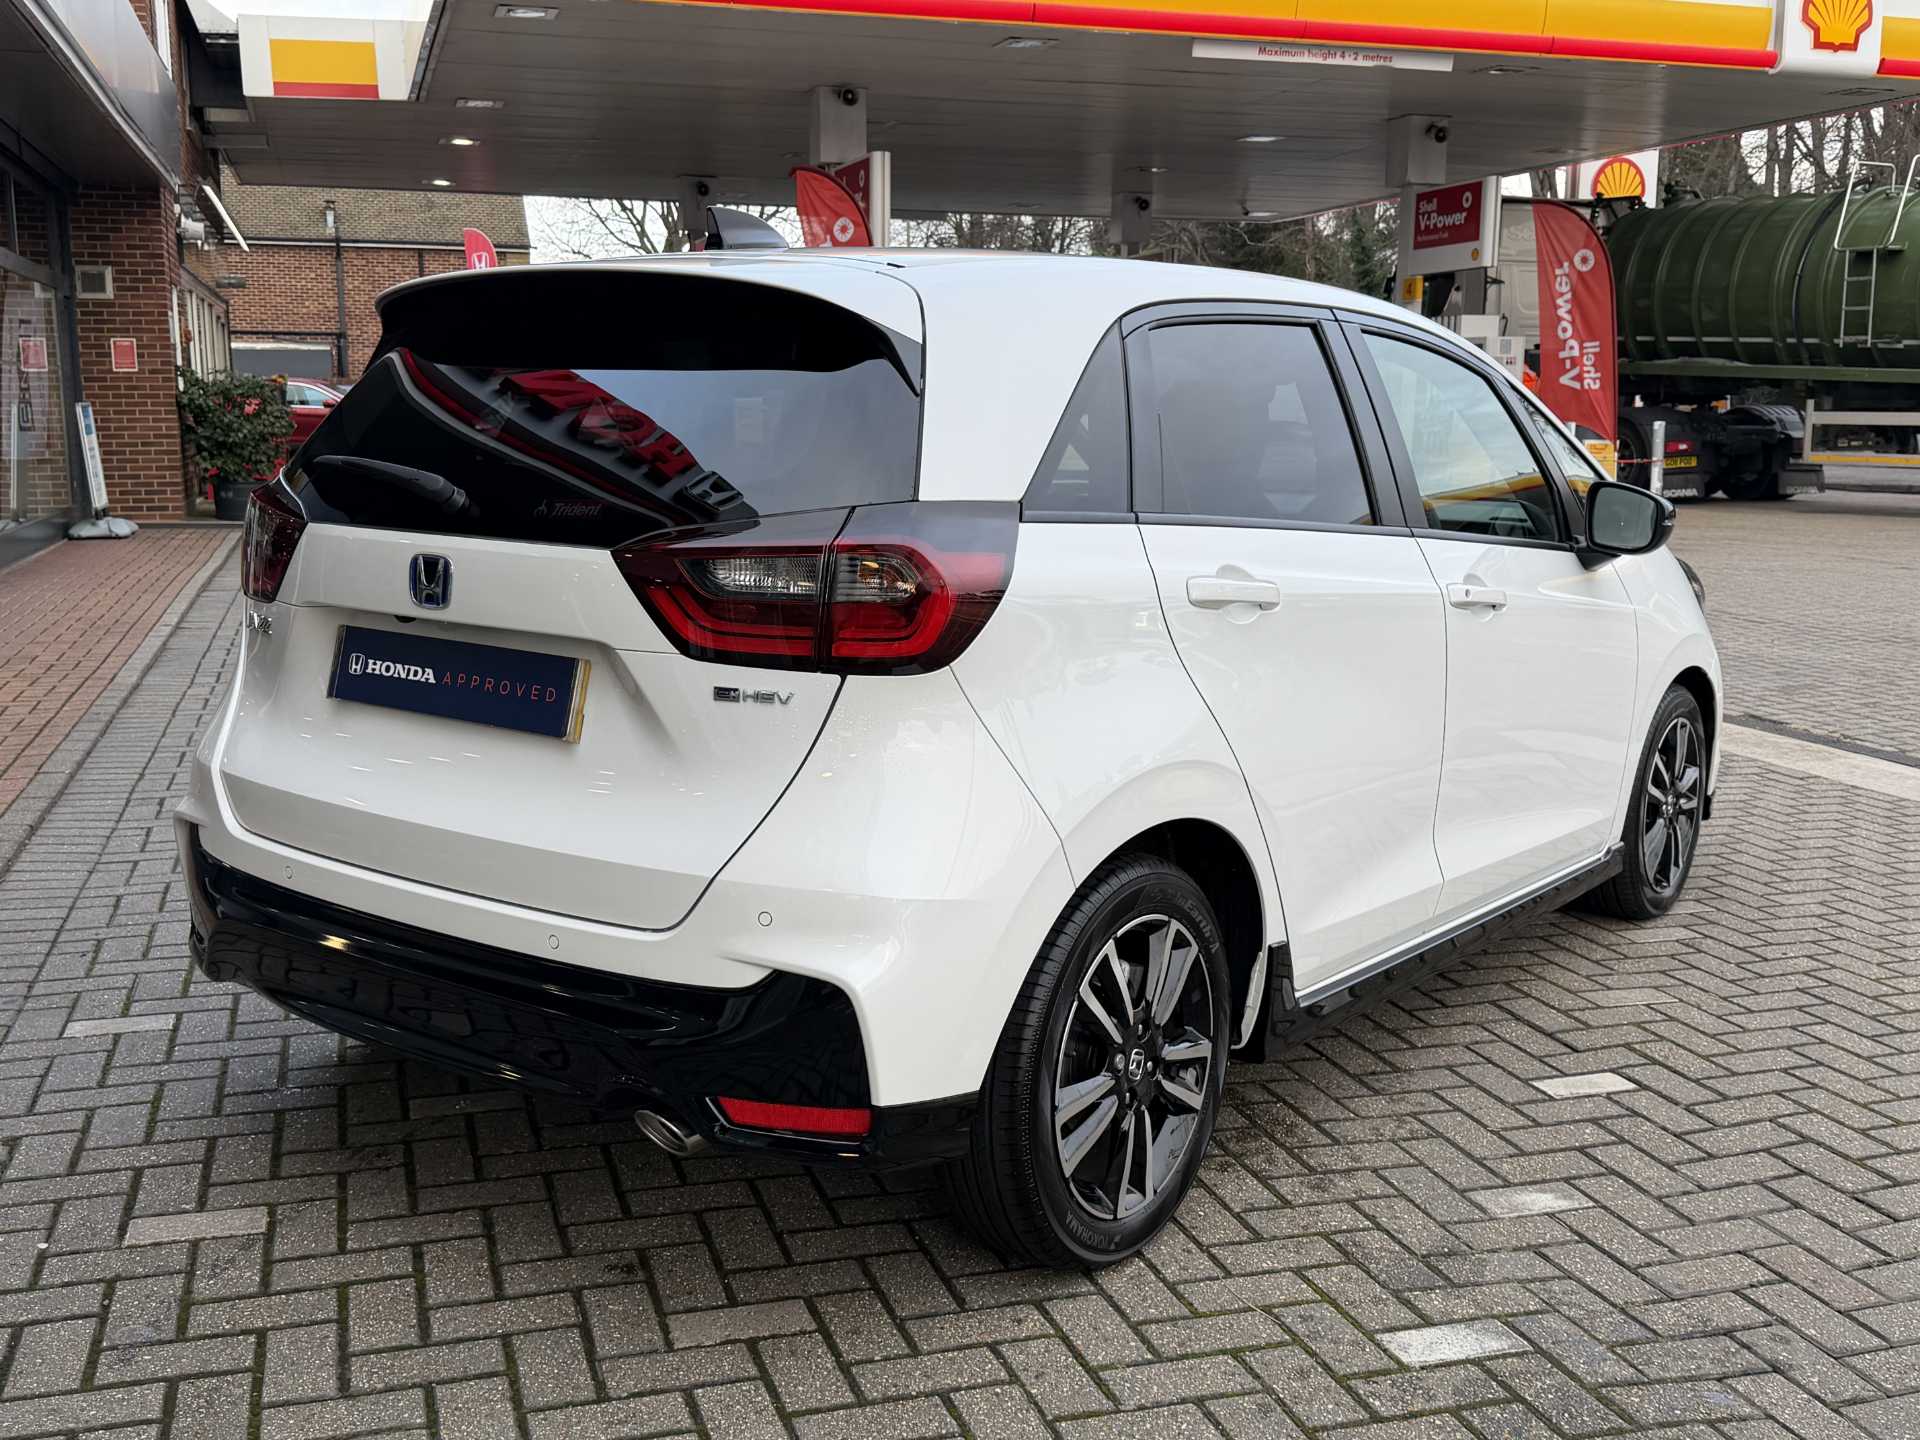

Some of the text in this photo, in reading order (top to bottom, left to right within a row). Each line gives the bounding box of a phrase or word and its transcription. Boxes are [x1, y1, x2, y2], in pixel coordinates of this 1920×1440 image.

[1258, 47, 1305, 58] Maximum
[1308, 48, 1337, 61] height
[1362, 54, 1393, 63] metres
[1663, 487, 1698, 498] SCANIA
[552, 502, 602, 516] Trident
[366, 658, 556, 702] HONDA APPROVED
